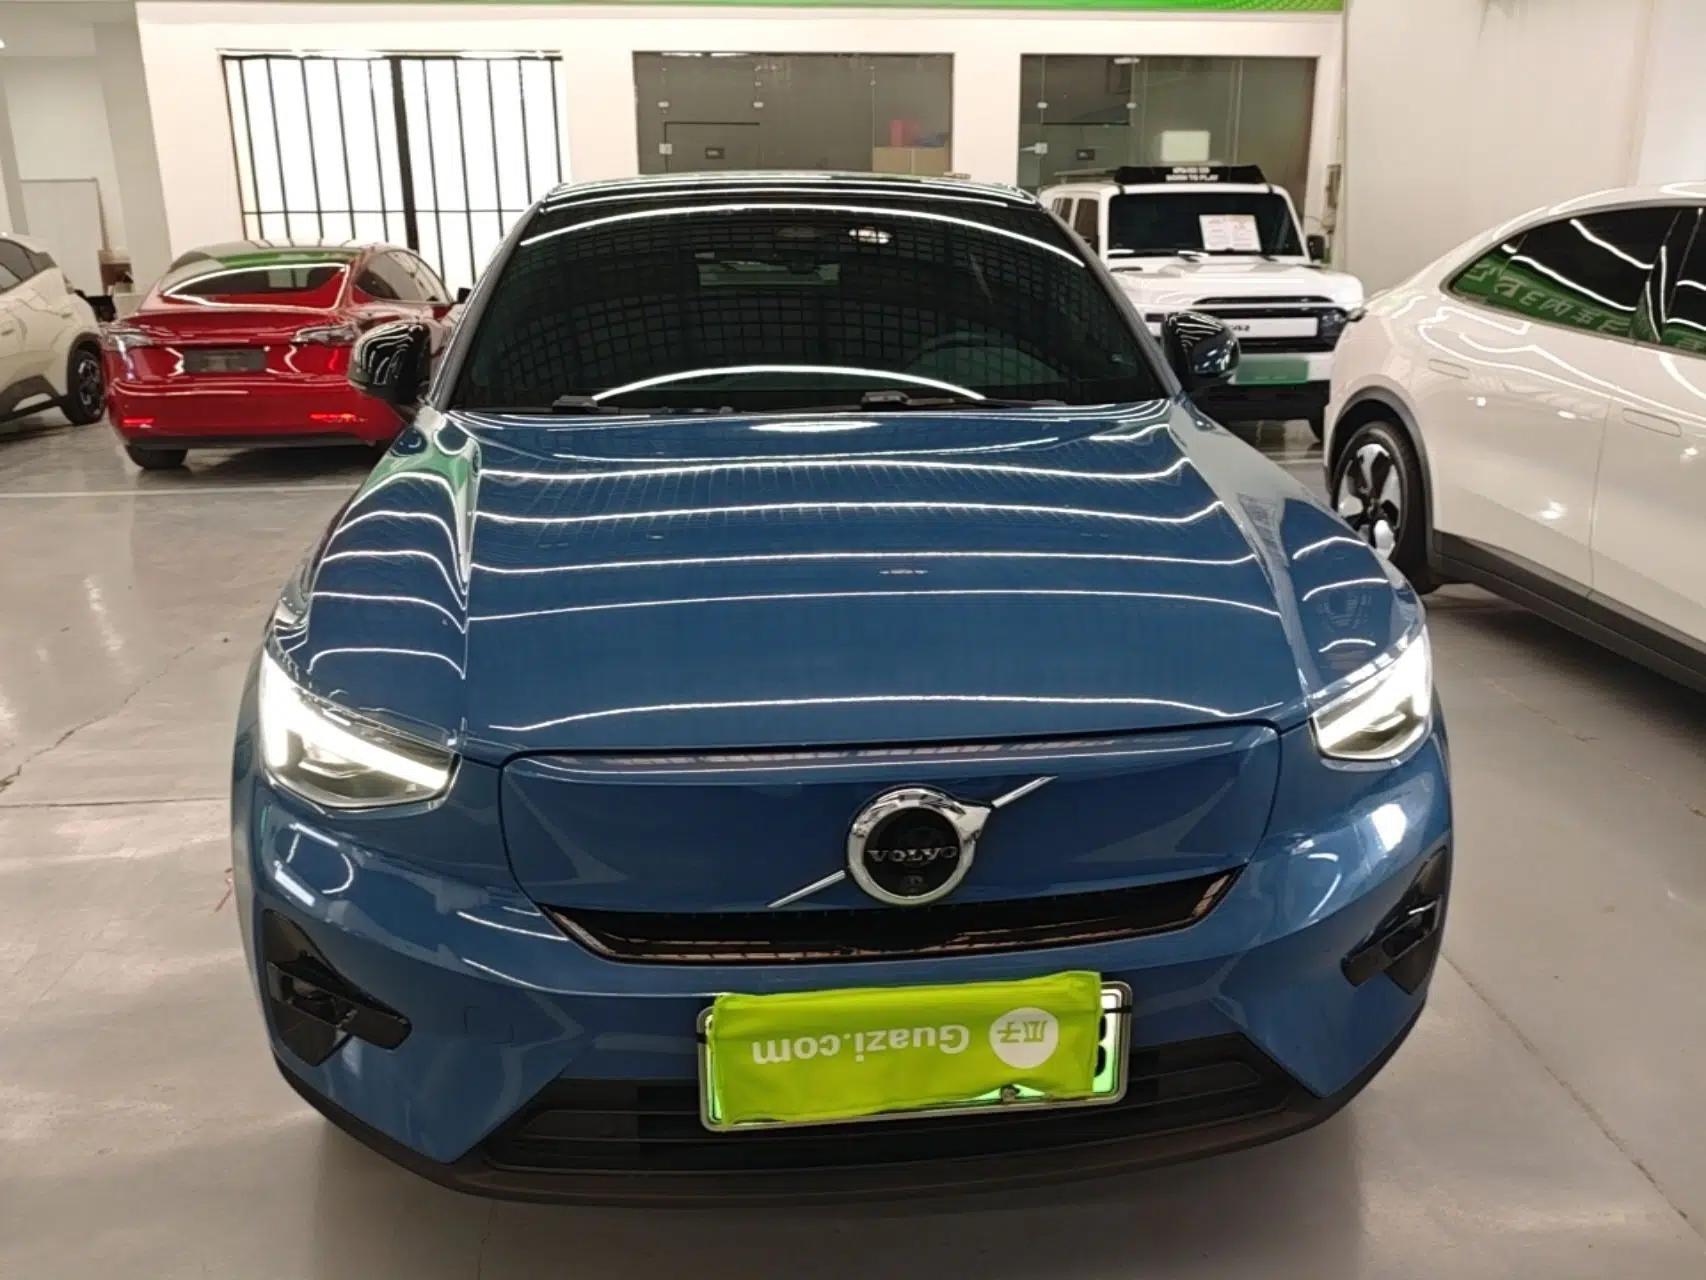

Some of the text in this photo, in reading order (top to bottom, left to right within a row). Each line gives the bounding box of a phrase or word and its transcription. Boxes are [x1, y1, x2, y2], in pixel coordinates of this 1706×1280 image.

[866, 846, 957, 863] VOLVO
[998, 1020, 1048, 1043] 瓜子
[752, 1024, 969, 1065] Guazi.com
